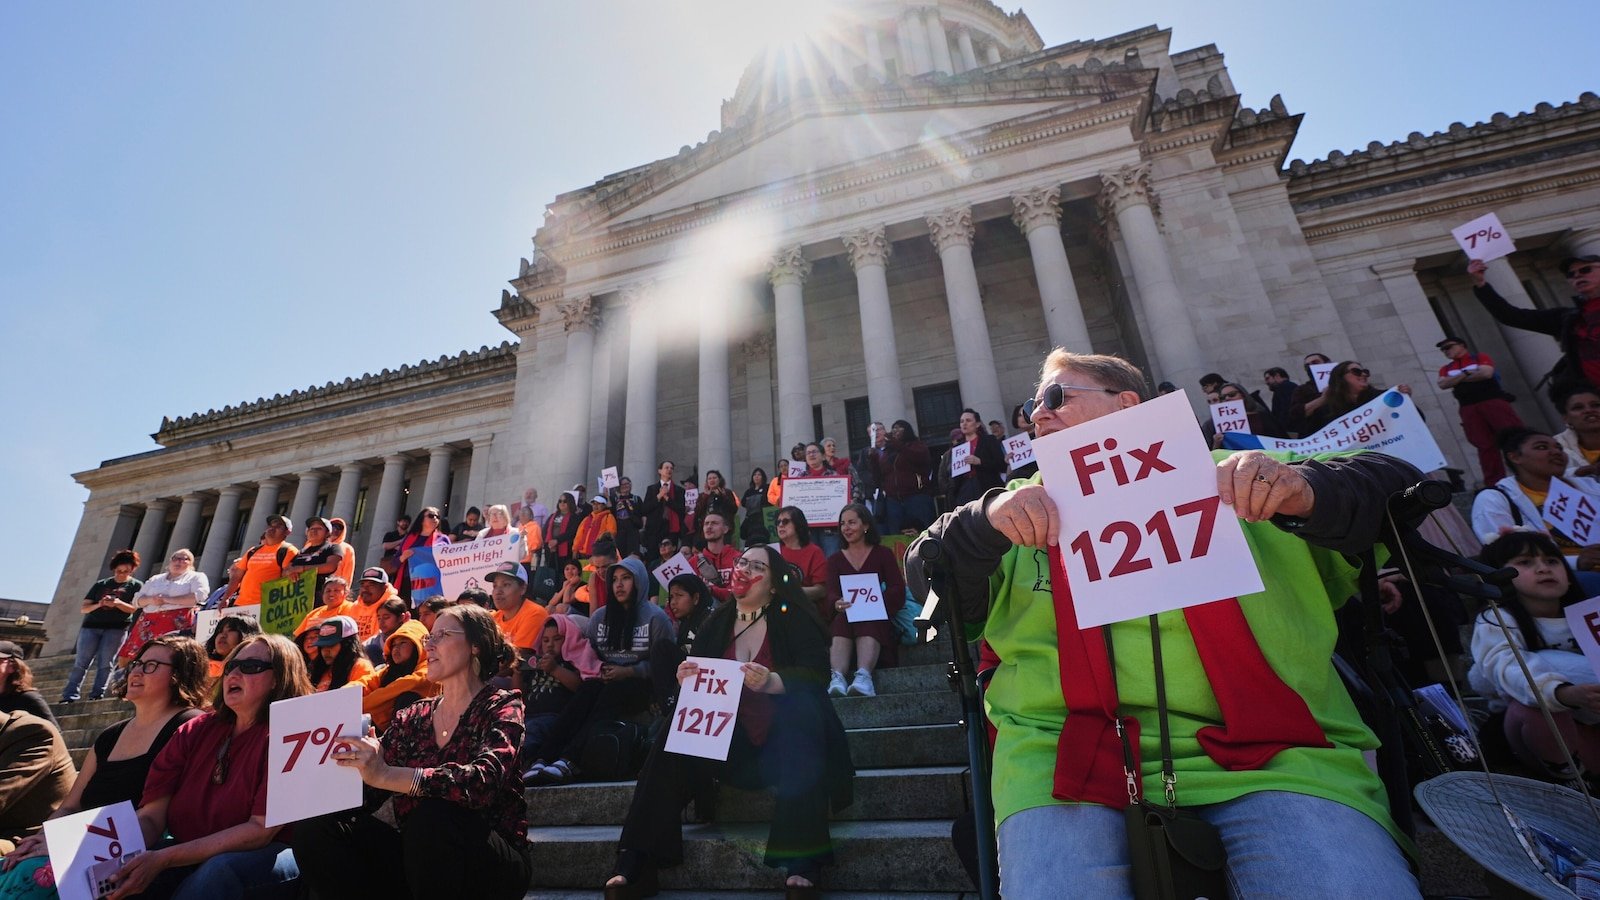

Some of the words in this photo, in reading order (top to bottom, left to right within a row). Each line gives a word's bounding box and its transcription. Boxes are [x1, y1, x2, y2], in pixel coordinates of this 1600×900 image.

[1464, 226, 1502, 249] 7%
[1218, 406, 1239, 417] Fix
[1216, 419, 1246, 433] 1217
[1274, 436, 1320, 449] Rent
[1322, 427, 1339, 440] is
[1339, 408, 1373, 429] Too
[1337, 418, 1387, 443] High!
[955, 448, 966, 457] Fix
[1009, 439, 1027, 451] Fix
[1011, 448, 1033, 464] 1217
[604, 472, 616, 481] 7%
[1069, 437, 1177, 497] Fix
[1549, 492, 1570, 522] Fix
[1572, 495, 1597, 543] 1217
[440, 545, 467, 555] Rent
[482, 538, 503, 547] Too
[1070, 495, 1221, 583] 1217
[438, 556, 470, 569] Damn
[473, 549, 504, 562] High!
[661, 563, 684, 580] Fix
[268, 578, 304, 604] BLUE
[847, 587, 878, 604] 7%
[265, 595, 308, 623] COLLAR
[277, 617, 294, 629] NOT
[693, 667, 729, 695] Fix
[677, 706, 734, 737] 1217
[281, 723, 352, 774] 7%
